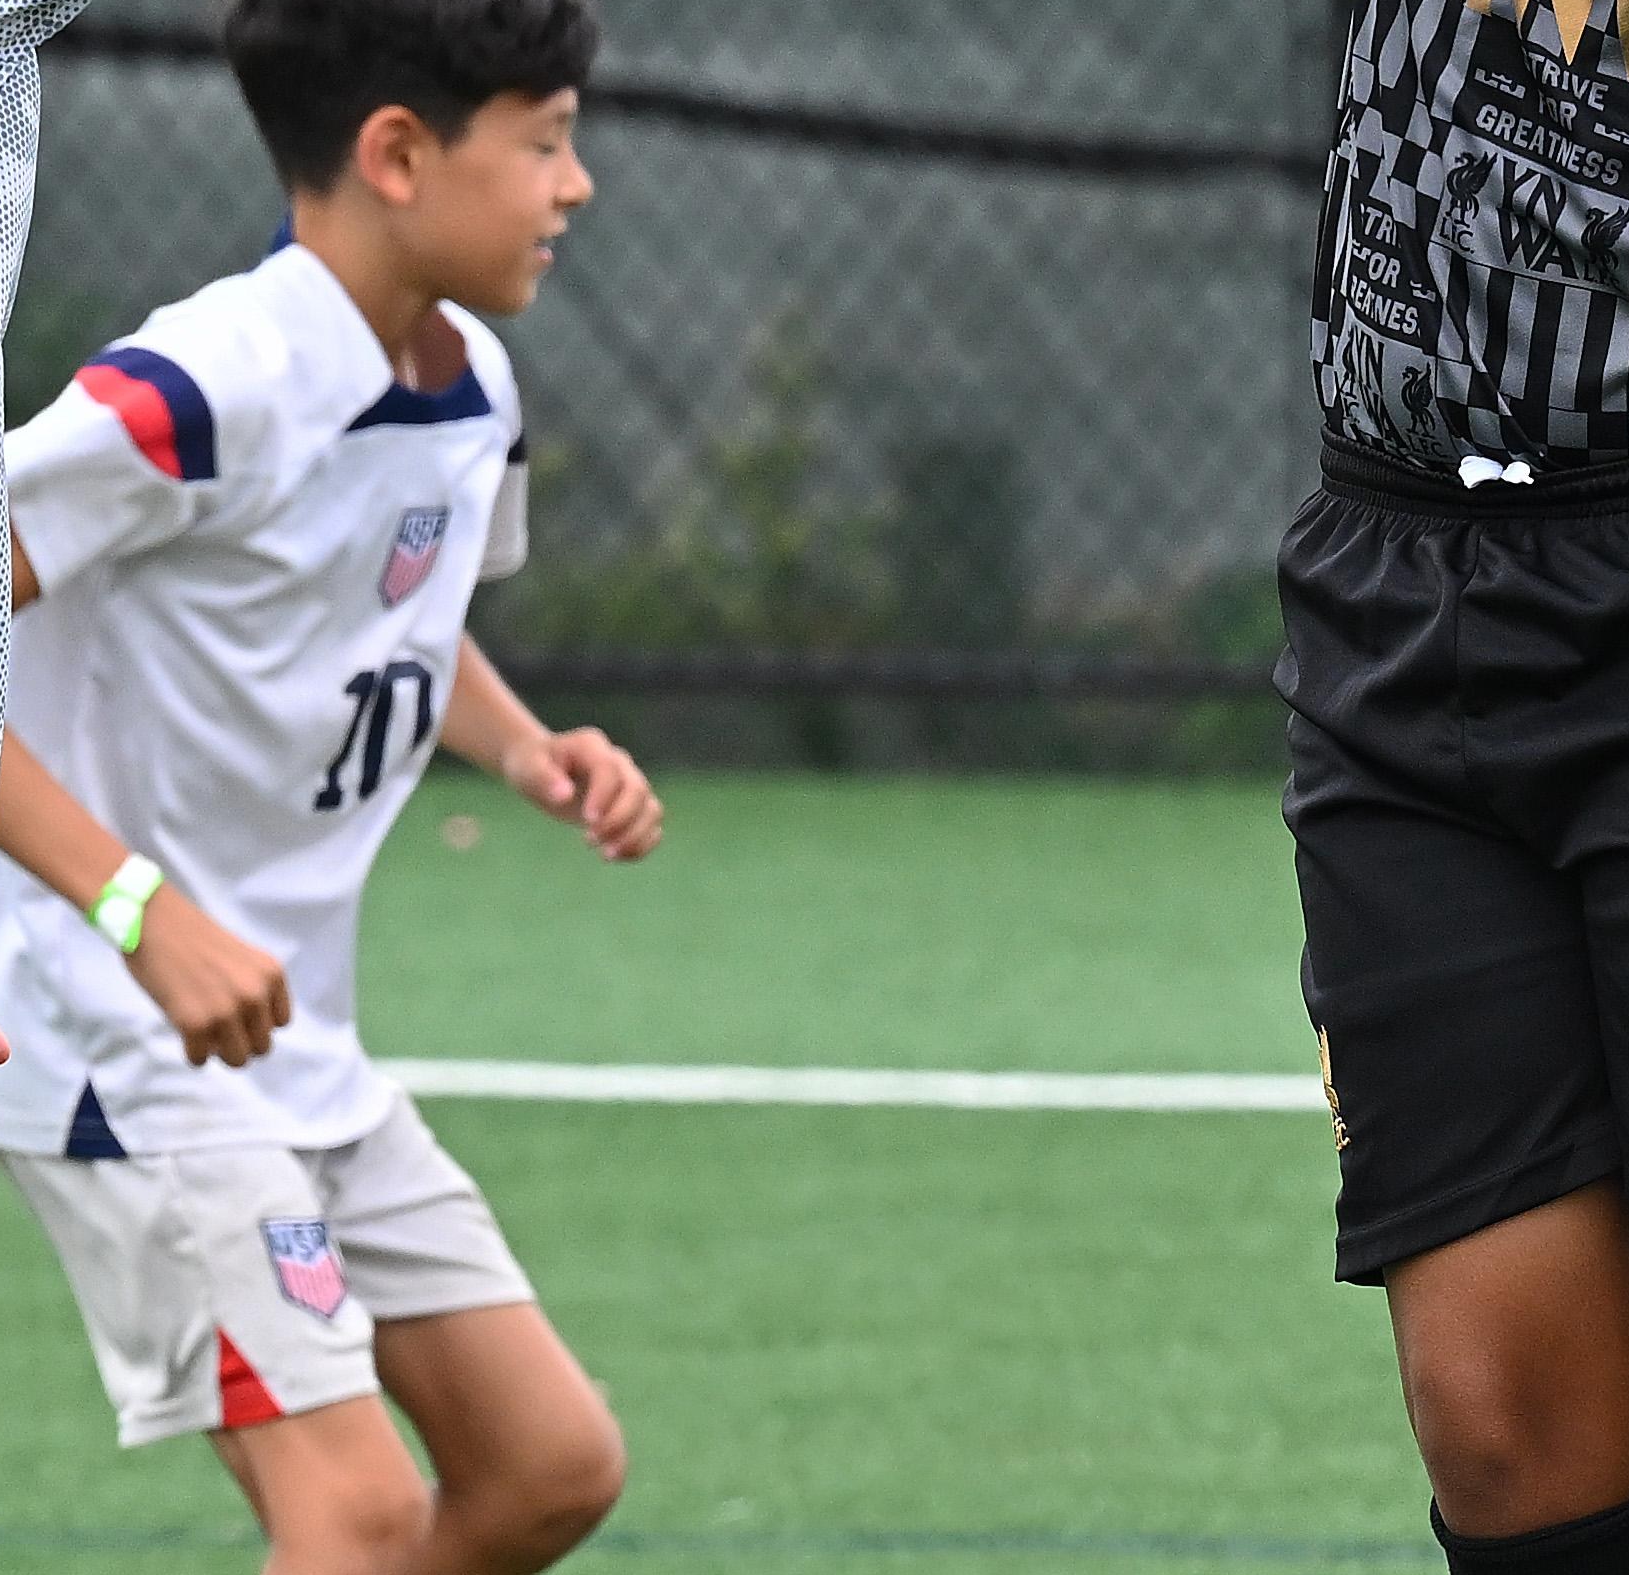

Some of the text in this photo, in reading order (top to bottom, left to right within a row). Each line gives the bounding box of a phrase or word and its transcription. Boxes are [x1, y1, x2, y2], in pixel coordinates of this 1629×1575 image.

[1475, 103, 1624, 186] GREATNESS
[1502, 154, 1568, 233] YN
[1368, 251, 1401, 289] OR
[1496, 207, 1579, 281] WA
[312, 660, 432, 811] 10
